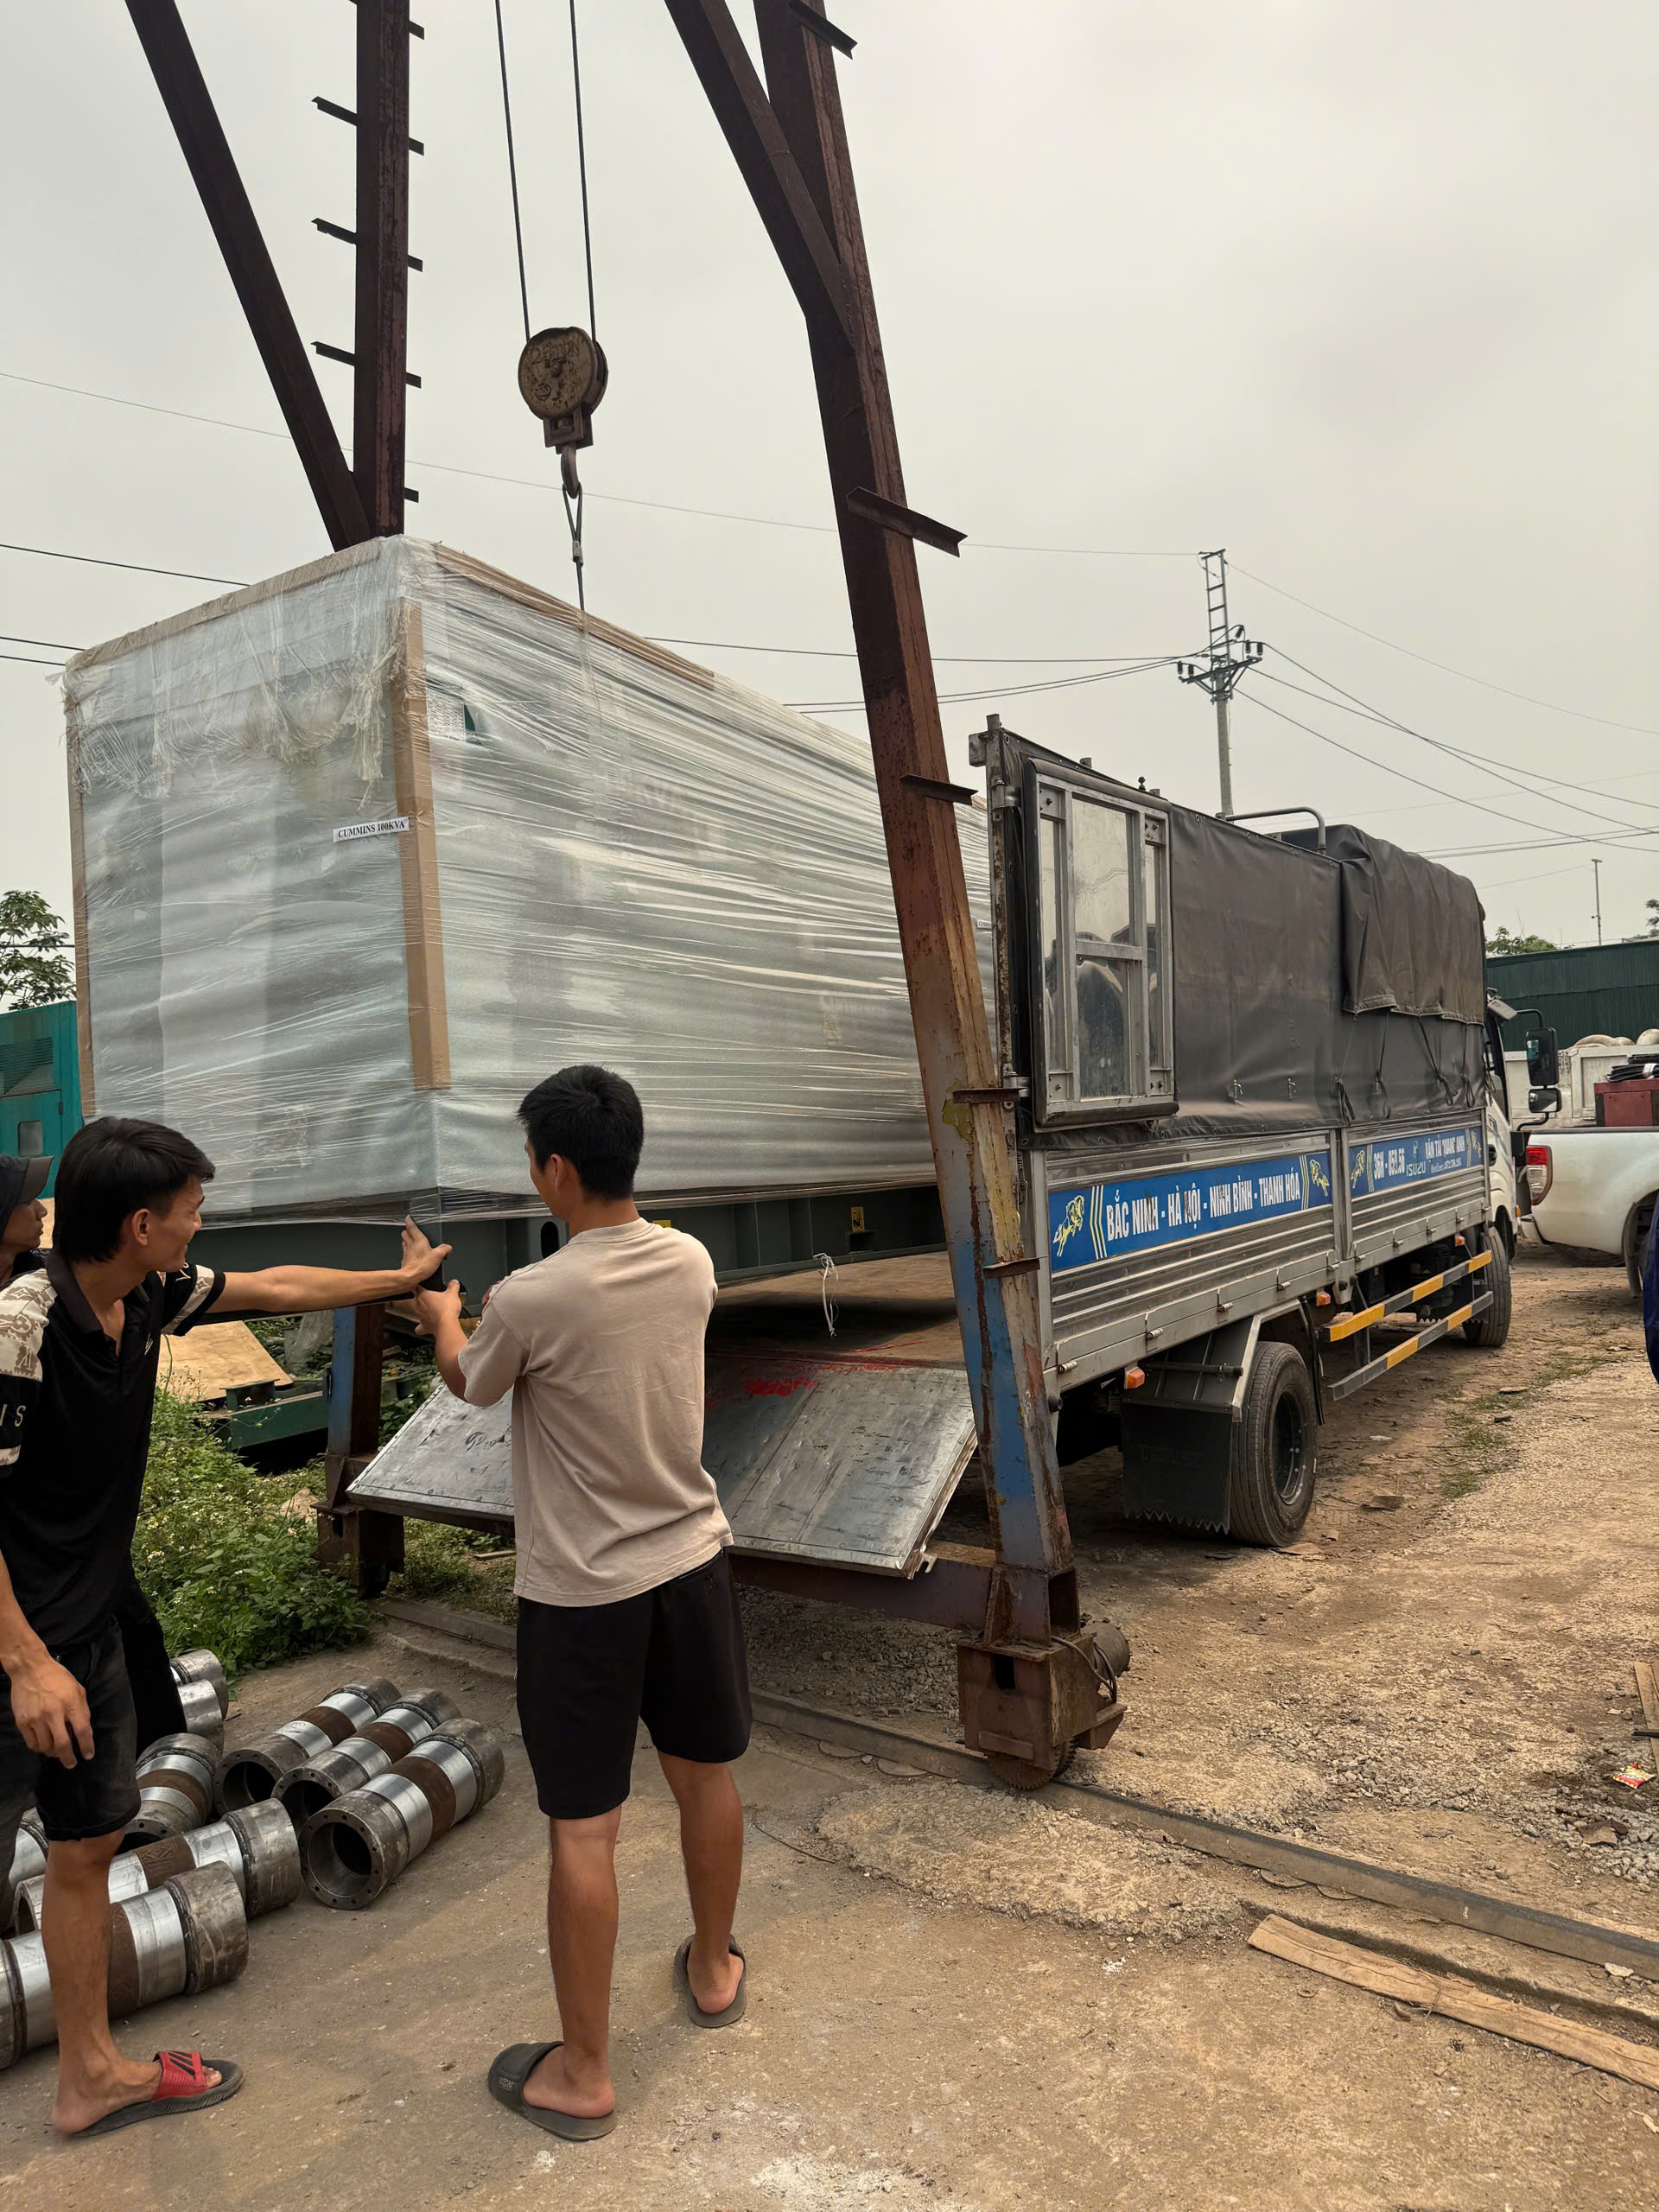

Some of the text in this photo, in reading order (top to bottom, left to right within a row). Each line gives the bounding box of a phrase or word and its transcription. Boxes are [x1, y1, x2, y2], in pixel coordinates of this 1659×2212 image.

[338, 820, 405, 838] CUMMINS 100KVA
[1406, 1160, 1426, 1177] ISUZU
[1106, 1189, 1129, 1242] BẮC
[1132, 1196, 1159, 1236] NINH
[1167, 1185, 1182, 1227] HÀ
[1184, 1182, 1201, 1230] NỘI
[1209, 1183, 1231, 1218] NINH
[1232, 1175, 1253, 1213] BÌNH
[1258, 1174, 1285, 1207] THANH
[1285, 1166, 1300, 1202] HÓA
